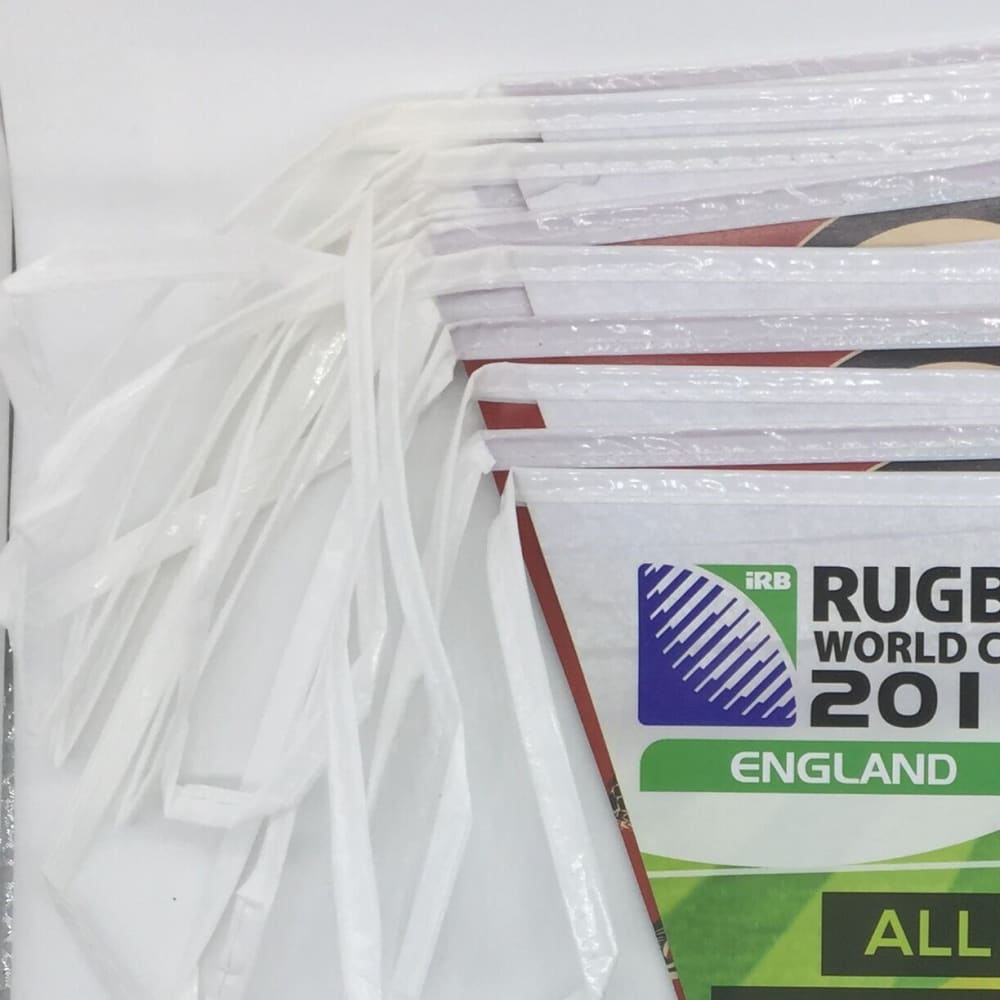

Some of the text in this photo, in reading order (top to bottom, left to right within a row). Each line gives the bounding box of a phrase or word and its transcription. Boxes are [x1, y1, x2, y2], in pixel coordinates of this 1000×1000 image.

[815, 630, 967, 664] WORLD
[730, 751, 958, 786] ENGLAND
[864, 909, 992, 958] ALL
